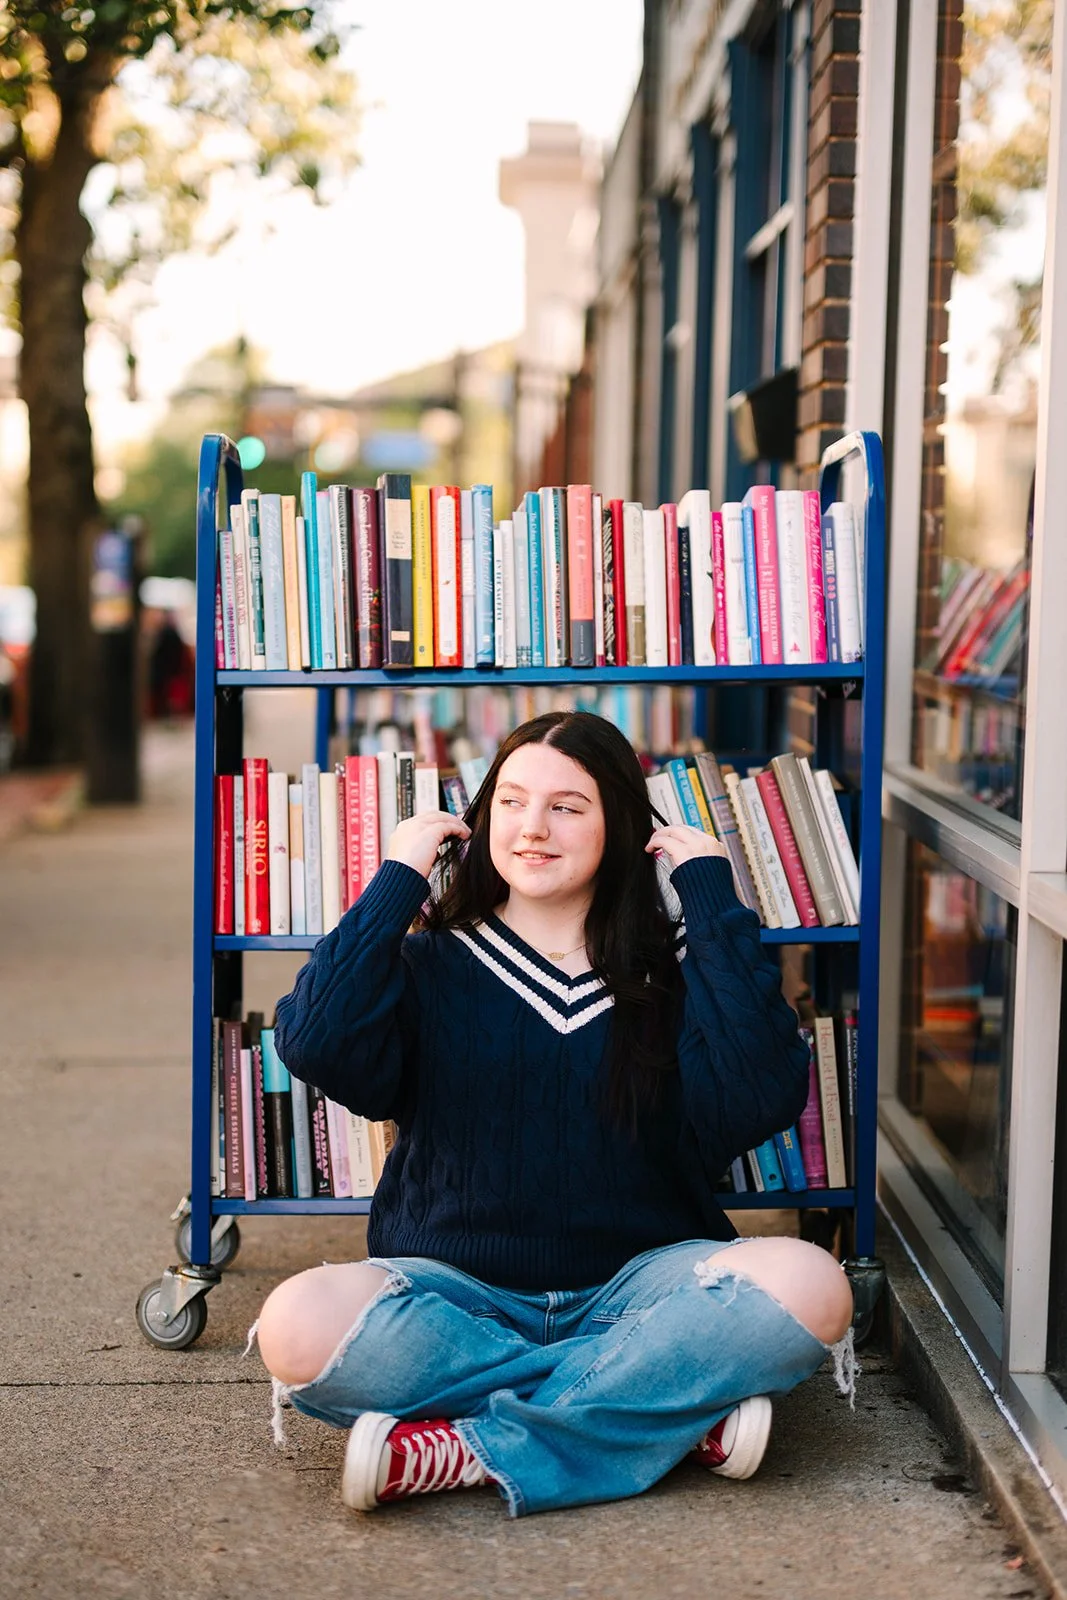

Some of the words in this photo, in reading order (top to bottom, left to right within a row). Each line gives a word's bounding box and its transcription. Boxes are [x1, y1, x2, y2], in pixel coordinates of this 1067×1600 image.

[358, 494, 372, 523] George
[481, 506, 492, 533] Made
[760, 506, 769, 539] American
[483, 536, 493, 547] in
[714, 534, 724, 568] Everlasting
[762, 540, 770, 564] Dream
[361, 550, 372, 581] Cuisine
[482, 549, 494, 595] Marseille
[812, 544, 822, 570] Words
[362, 582, 373, 593] of
[716, 568, 724, 590] Meal
[810, 577, 824, 606] Mimi
[360, 594, 374, 628] Hungary
[812, 607, 826, 642] Sheraton
[228, 624, 236, 655] DOUGLAS
[350, 782, 360, 825] JULEE
[364, 769, 376, 808] GREAT
[363, 810, 378, 853] GOOD
[745, 822, 756, 845] United
[252, 820, 266, 876] SIRIO
[350, 834, 360, 882] ROSSO
[750, 845, 769, 890] Presbyterian
[813, 856, 826, 885] WILLIAMS
[764, 889, 776, 916] Church
[820, 1026, 831, 1054] Here
[822, 1056, 834, 1074] Let
[824, 1076, 835, 1090] Us
[826, 1092, 838, 1122] Feast
[232, 1116, 240, 1174] ESSENTIALS
[312, 1110, 322, 1170] WHISKY
[318, 1100, 329, 1179] CANADIAN
[782, 1132, 794, 1150] DIET
